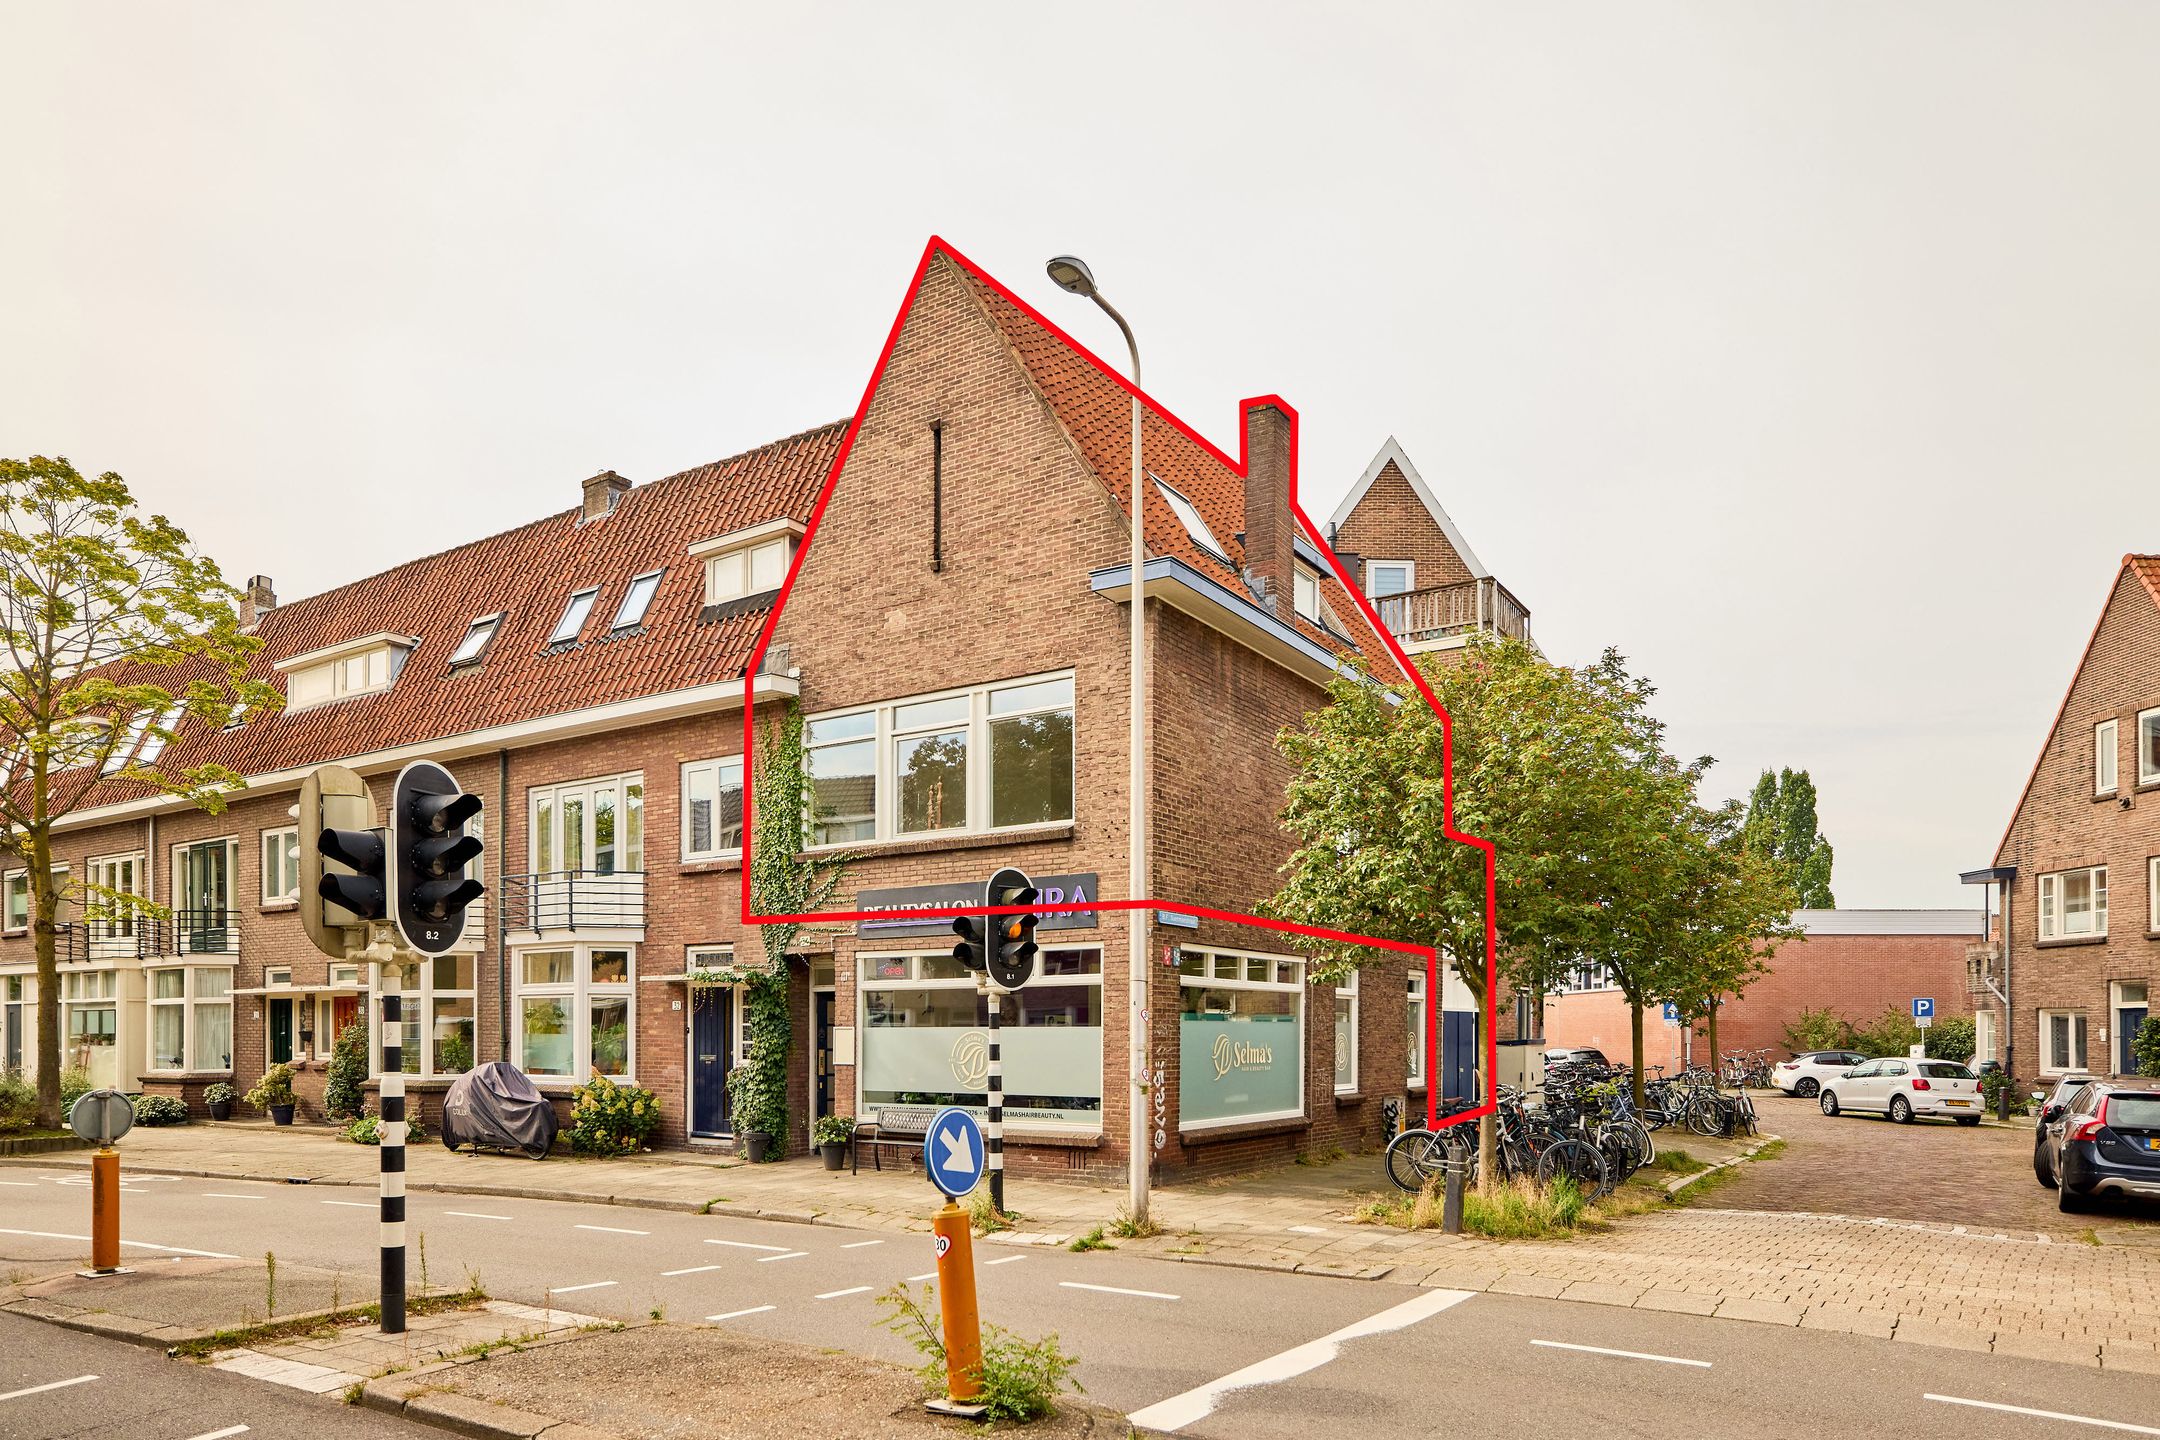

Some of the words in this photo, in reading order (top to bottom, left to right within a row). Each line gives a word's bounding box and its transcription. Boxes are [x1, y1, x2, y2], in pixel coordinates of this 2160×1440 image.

[426, 930, 439, 940] 8.2
[1917, 1000, 1930, 1015] P
[1233, 1040, 1272, 1067] Selma's
